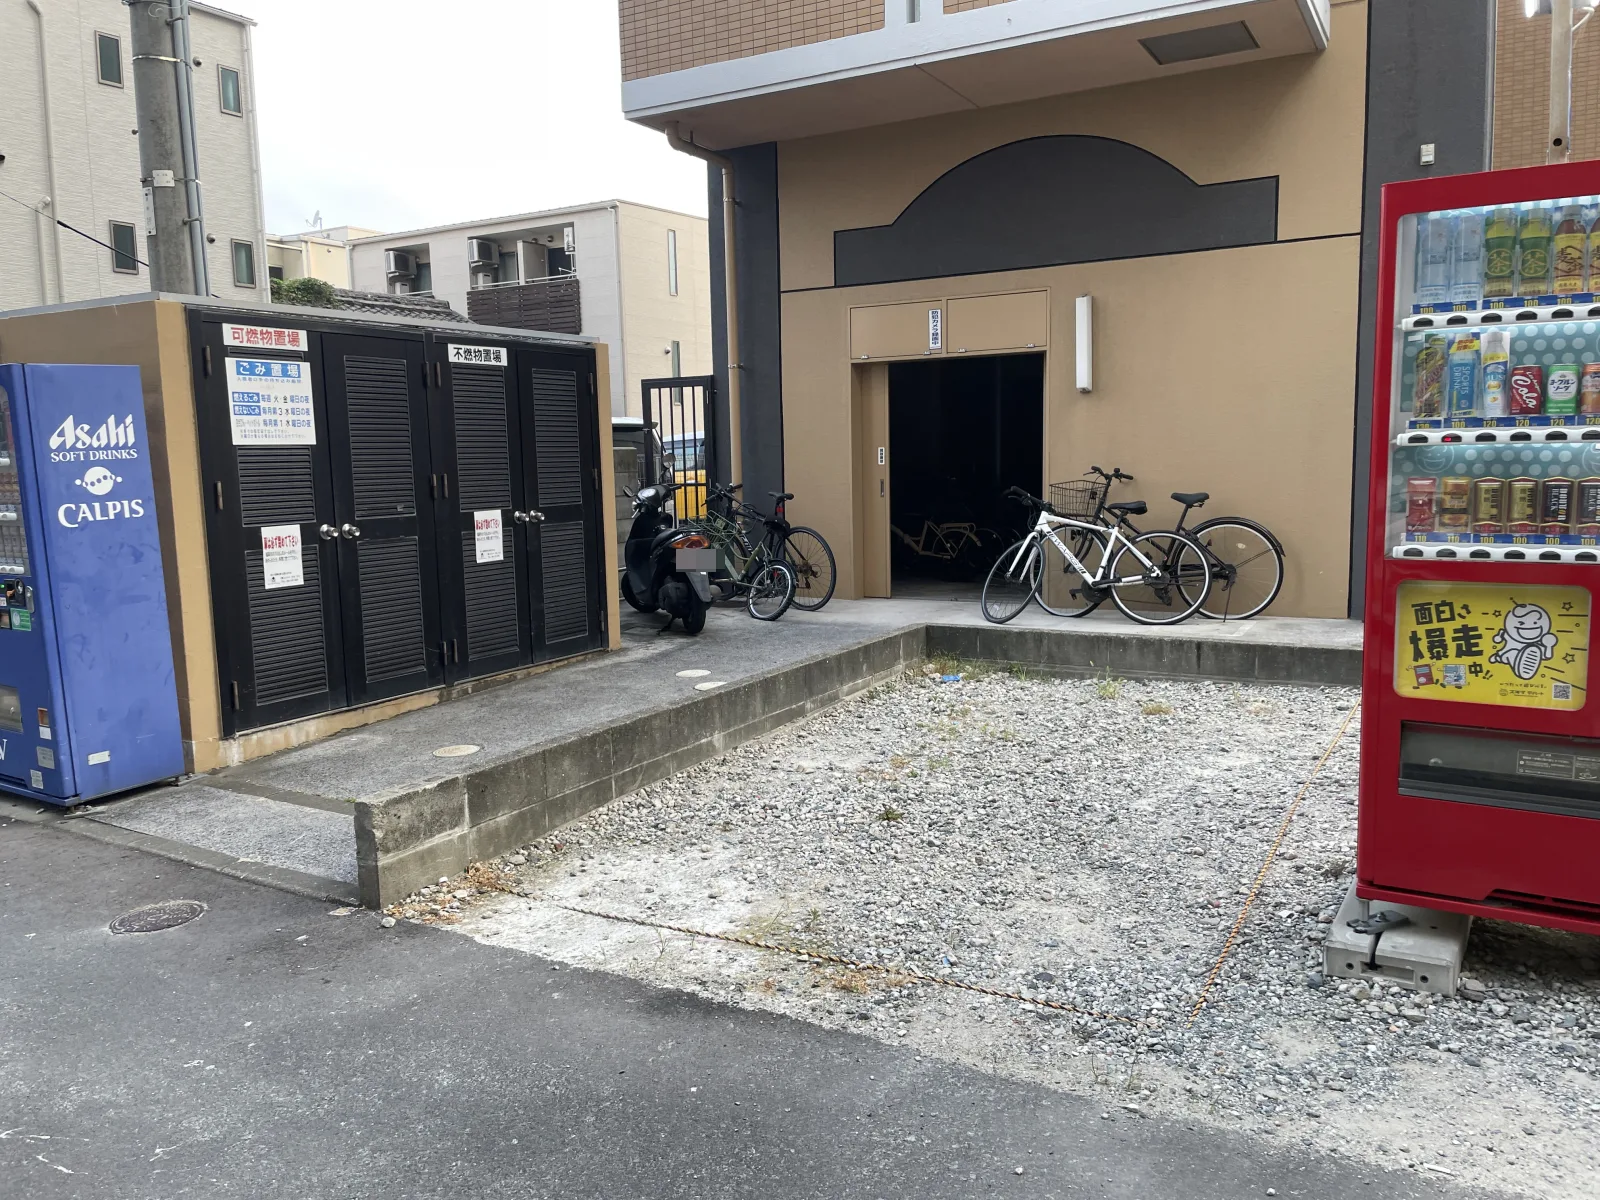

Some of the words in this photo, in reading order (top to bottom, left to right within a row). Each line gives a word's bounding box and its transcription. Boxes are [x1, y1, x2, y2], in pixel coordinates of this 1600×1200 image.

[1488, 252, 1512, 272] 茶
[1522, 252, 1546, 272] 茶
[1556, 247, 1583, 271] 麦茶
[231, 327, 301, 347] 可燃物置場
[453, 347, 502, 363] 不燃物置場
[240, 362, 299, 378] ごみ置場
[1453, 367, 1462, 392] DRINK
[1461, 366, 1471, 395] SPORTS
[1512, 376, 1537, 408] Cola
[49, 414, 135, 450] Asahi
[50, 451, 86, 463] SOFT
[89, 448, 138, 461] DRINKS
[1550, 488, 1560, 511] BLACK
[1588, 488, 1597, 512] BLACK
[58, 499, 144, 528] CALPIS
[1411, 600, 1472, 625] 面白さ
[1408, 624, 1484, 662] 爆走
